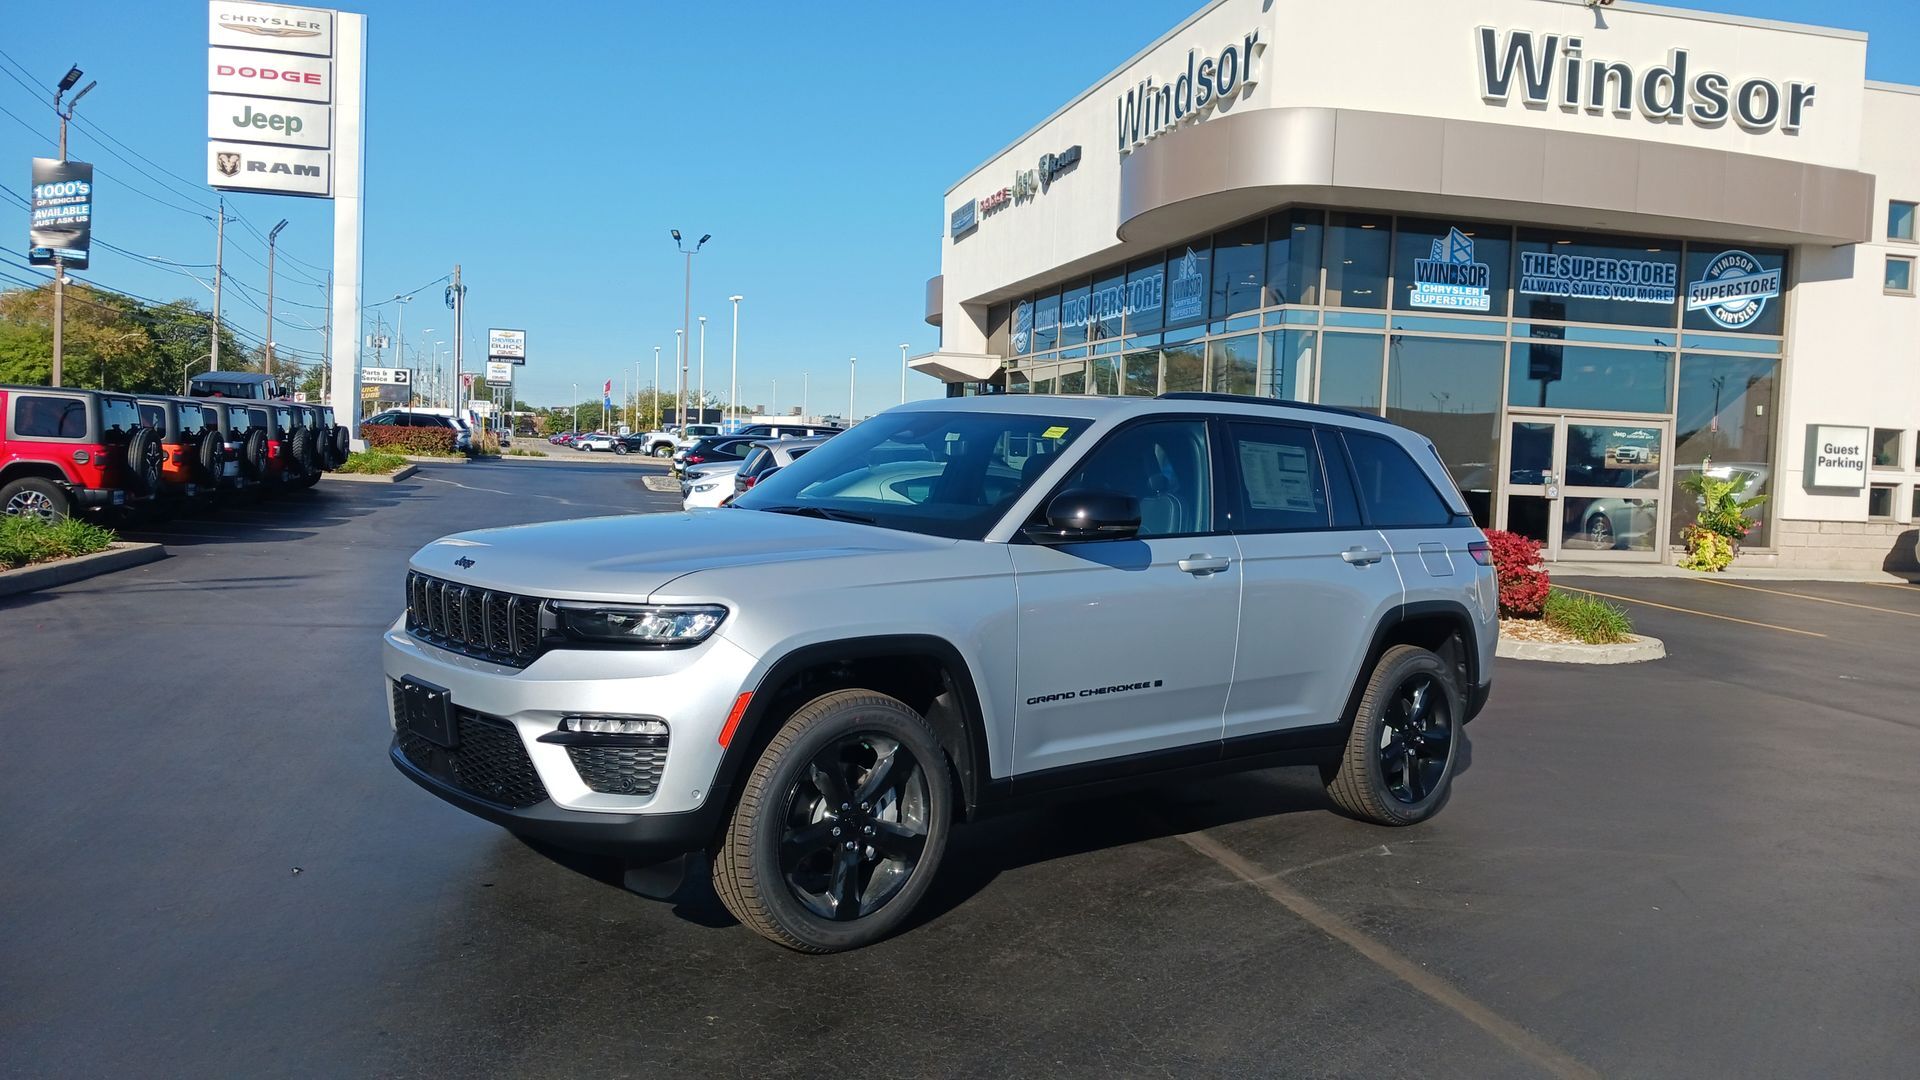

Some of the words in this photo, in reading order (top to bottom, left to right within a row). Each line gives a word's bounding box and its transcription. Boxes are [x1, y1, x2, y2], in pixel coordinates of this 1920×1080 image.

[219, 13, 321, 30] CHRYSLER
[217, 64, 322, 85] DODGE
[1475, 25, 1817, 130] Windsor
[1116, 27, 1264, 154] Windsor
[232, 105, 303, 136] Jeep
[246, 160, 321, 178] RAM
[34, 181, 90, 199] 1000's
[49, 196, 87, 204] VEHICLES
[34, 205, 89, 219] AVAILABLE
[34, 219, 55, 227] JUST
[1416, 261, 1488, 287] WINDSOR
[1523, 253, 1557, 277] THE
[1558, 255, 1676, 285] SUPERSTORE
[1710, 256, 1754, 277] WINDSOR
[1421, 284, 1480, 296] CHRYSLER
[1521, 278, 1569, 295] ALWAYS
[1571, 281, 1611, 297] SAVES
[1611, 286, 1635, 299] YOU
[1636, 288, 1674, 301] MORE!
[1692, 276, 1777, 303] SUPERSTORE
[1414, 294, 1488, 307] SUPERSTORE
[1715, 301, 1759, 323] CHRYSLER
[491, 342, 523, 351] BUICK
[1824, 443, 1860, 456] Guest
[1817, 456, 1864, 472] Parking
[454, 555, 476, 570] Jeep
[1027, 691, 1075, 705] GRAND
[1079, 680, 1151, 698] CHEROKEE
